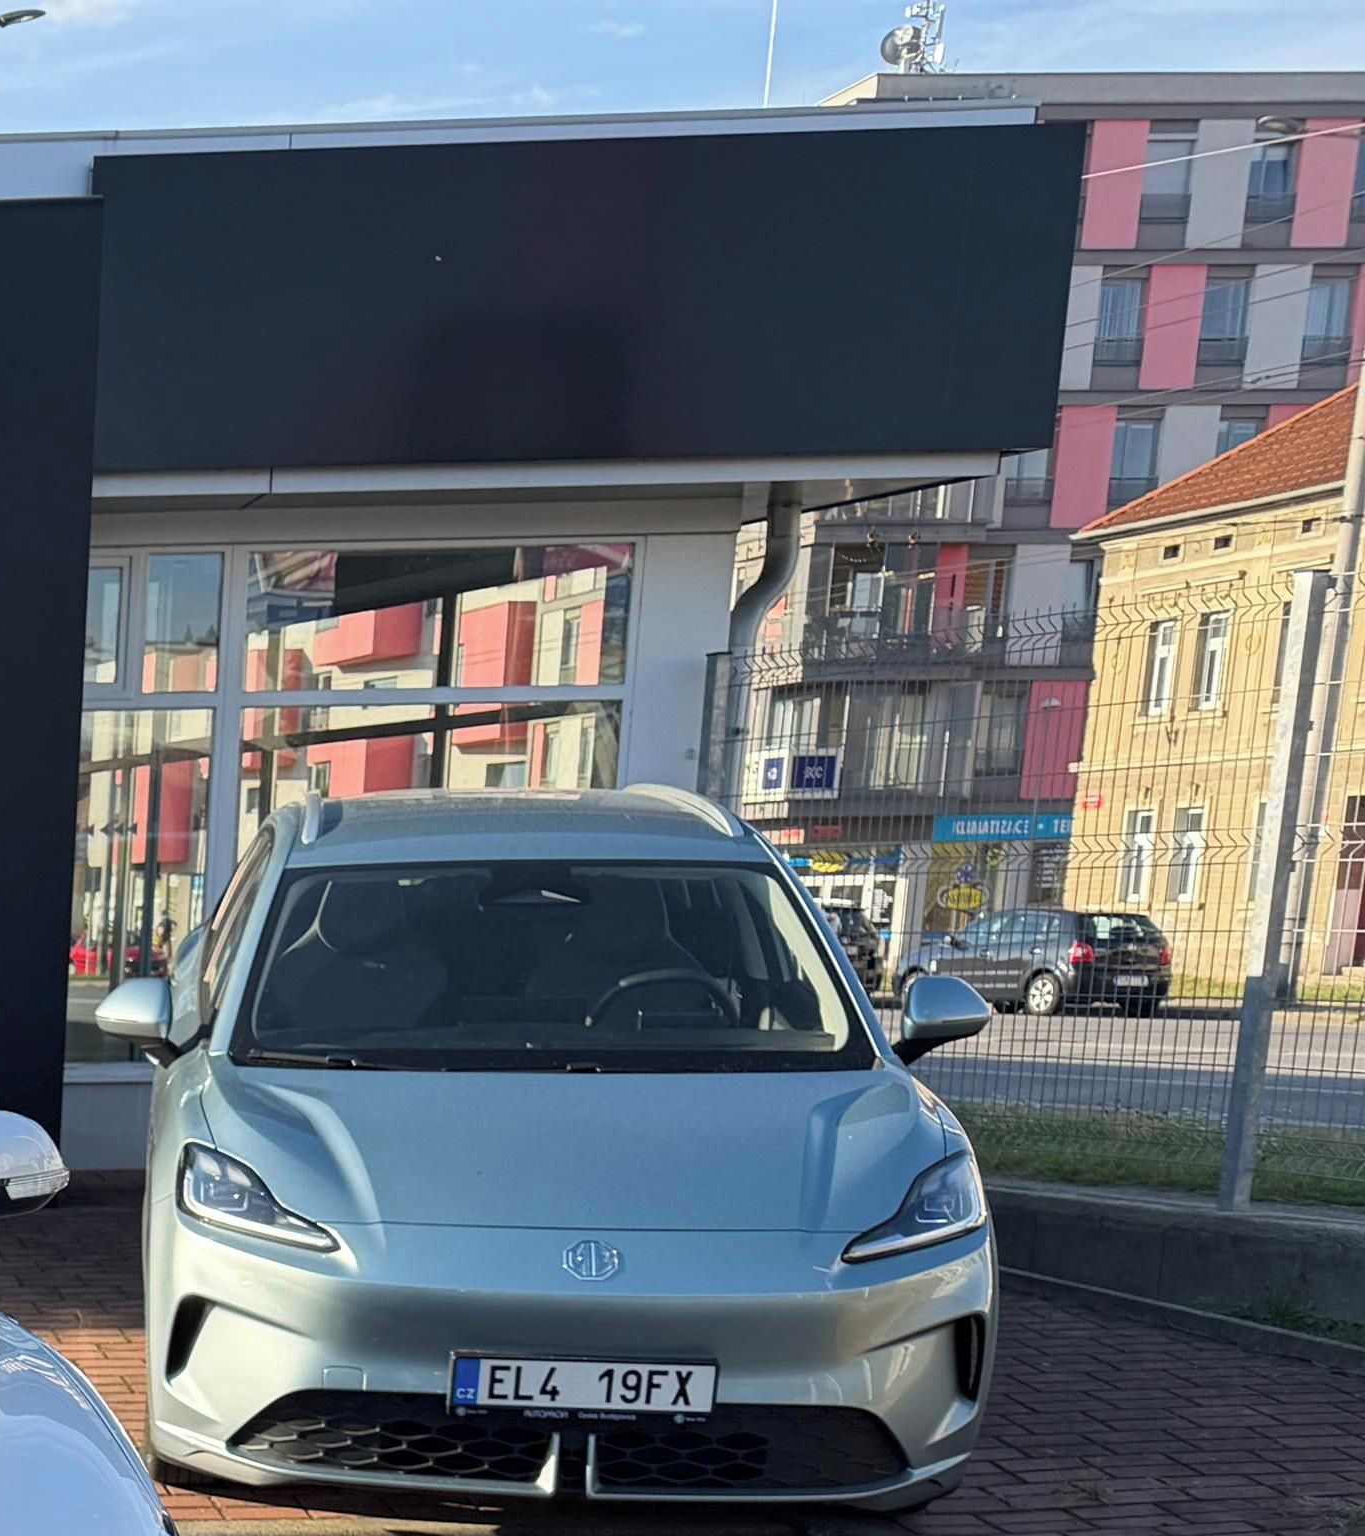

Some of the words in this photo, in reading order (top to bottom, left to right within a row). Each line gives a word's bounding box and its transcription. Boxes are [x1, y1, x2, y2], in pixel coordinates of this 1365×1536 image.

[456, 1387, 475, 1399] CZ
[487, 1365, 561, 1402] EL4
[598, 1368, 693, 1406] 19FX
